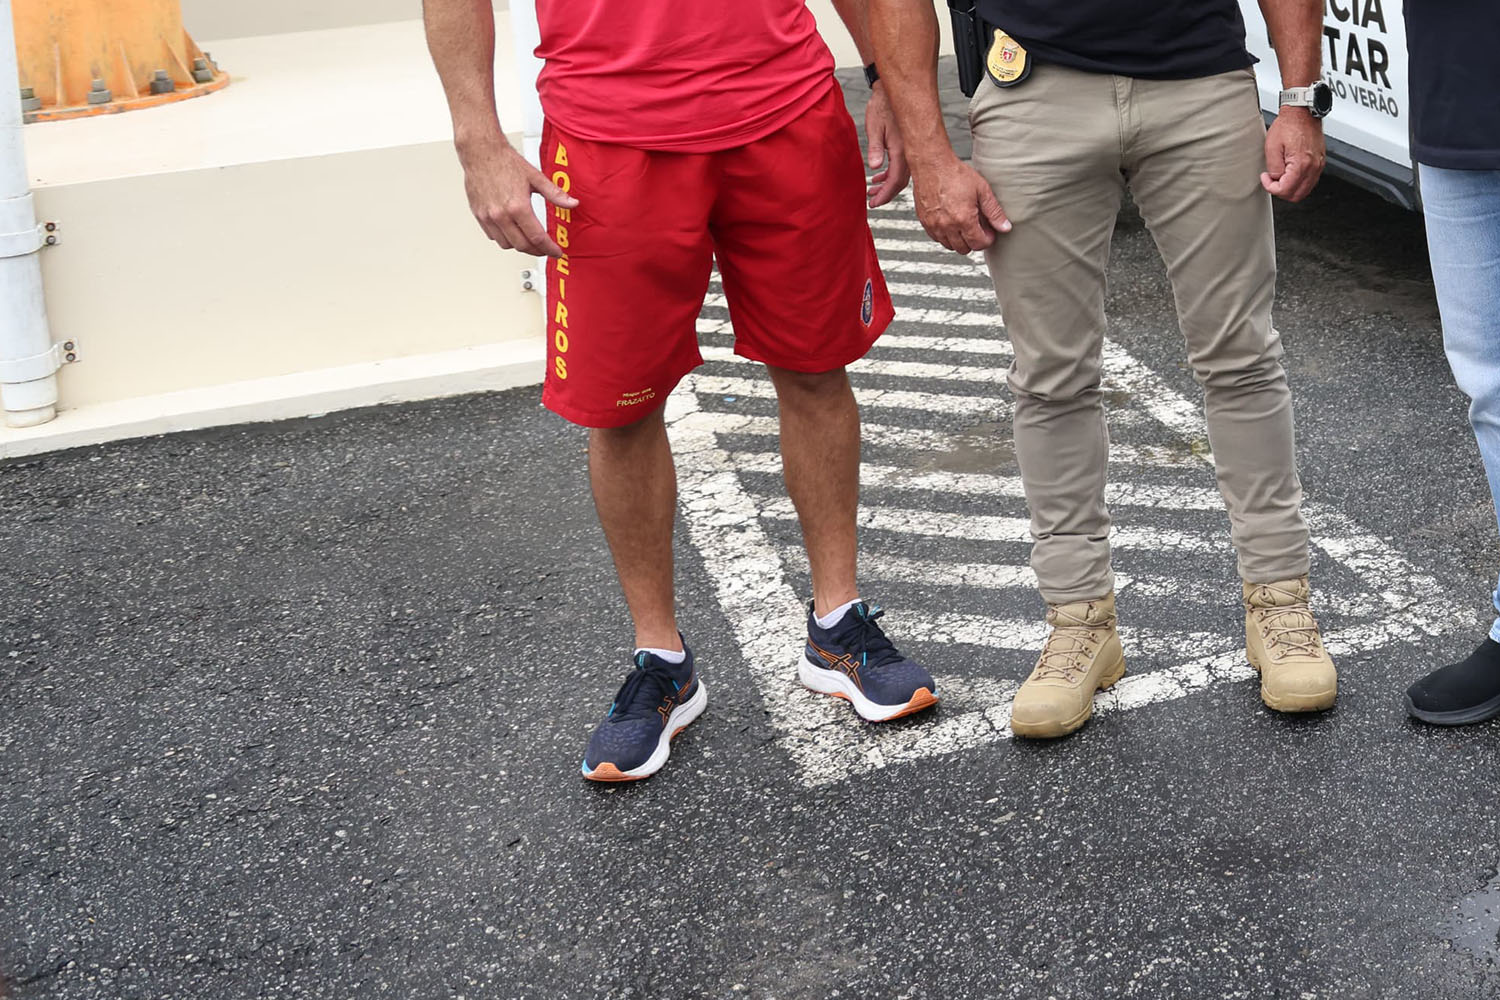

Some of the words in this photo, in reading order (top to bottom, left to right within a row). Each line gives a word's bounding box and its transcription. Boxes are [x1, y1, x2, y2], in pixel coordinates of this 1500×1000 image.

[1322, 25, 1393, 90] TAR
[1349, 83, 1399, 118] VERÃO
[551, 141, 572, 381] BOMBEIROS
